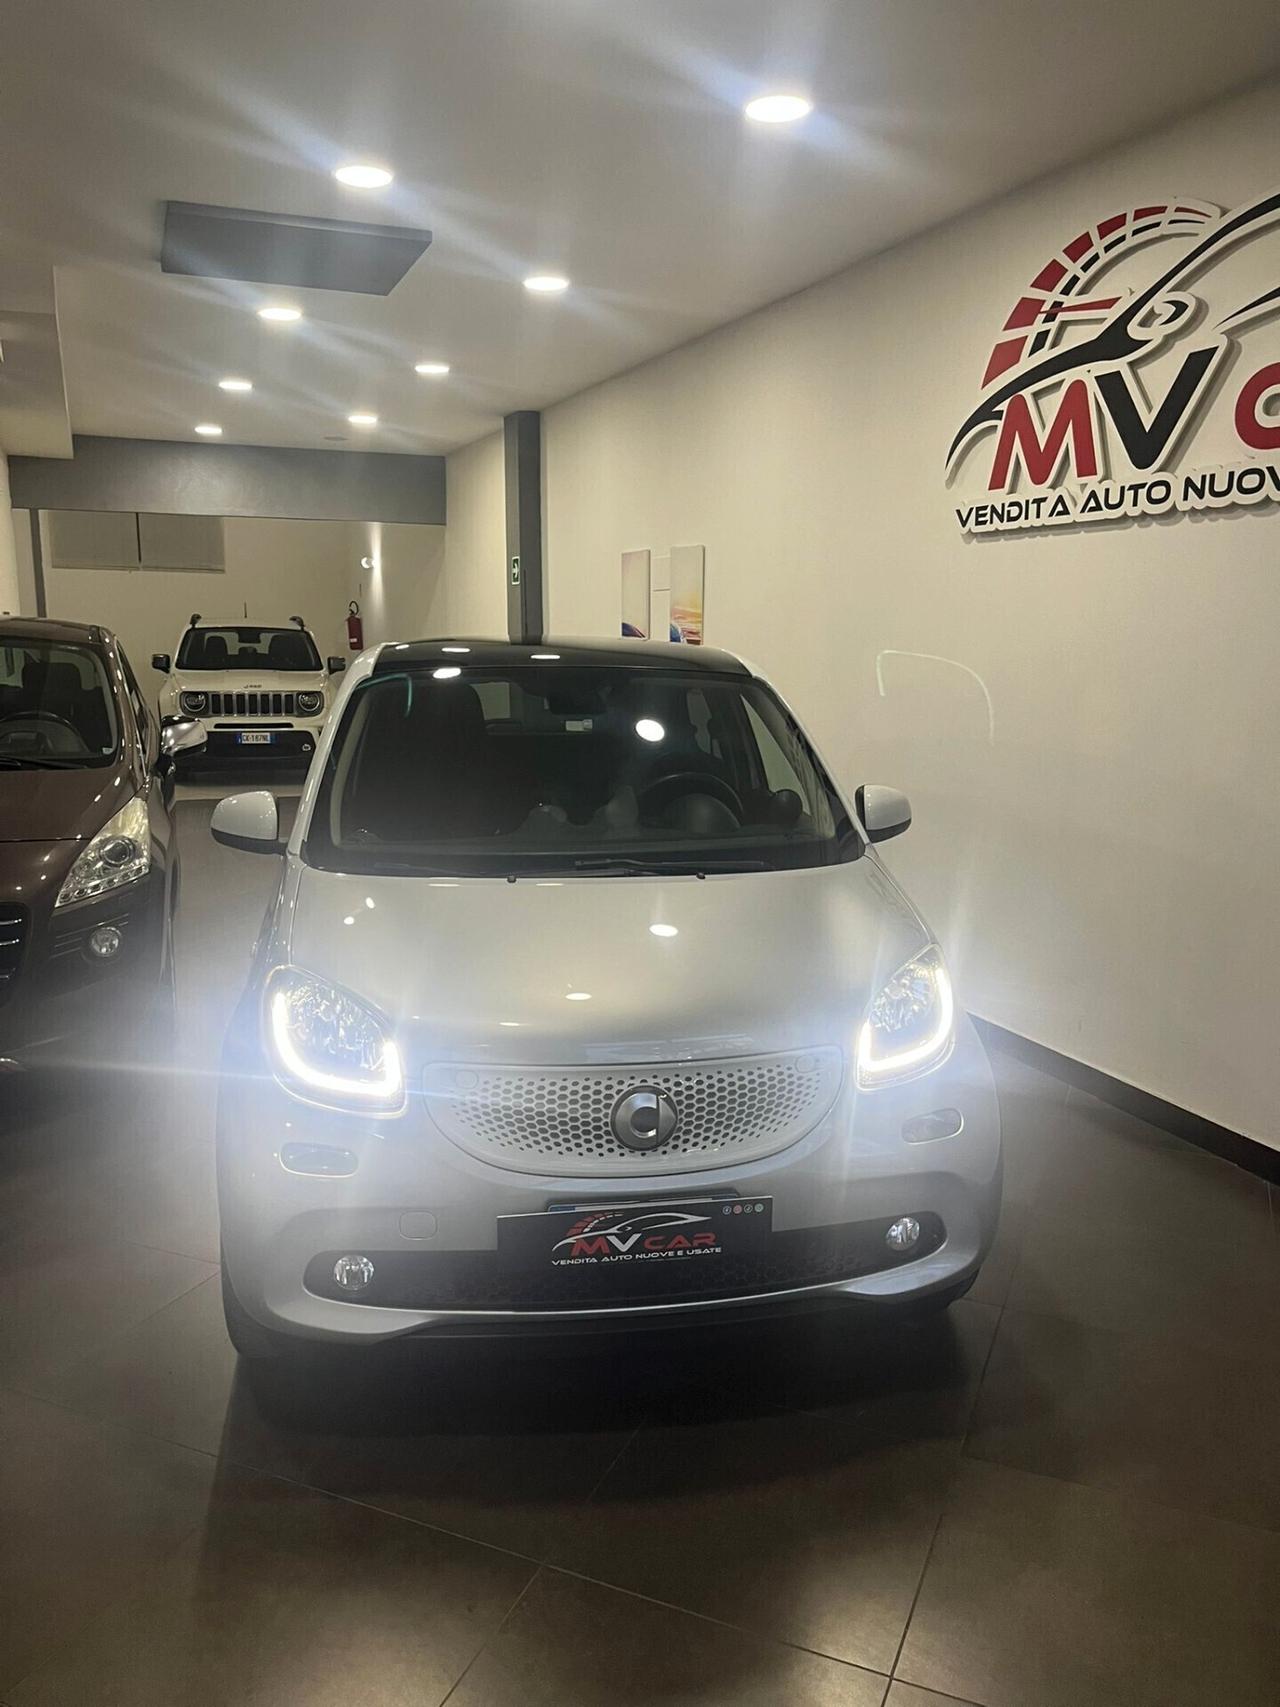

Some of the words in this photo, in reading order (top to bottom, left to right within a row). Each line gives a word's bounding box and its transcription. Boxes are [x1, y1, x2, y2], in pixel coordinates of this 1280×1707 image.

[955, 494, 1071, 528] VENDITA
[1079, 479, 1171, 514] AUTO
[644, 1232, 717, 1250] CAR
[551, 1257, 598, 1266] VENDITA
[601, 1254, 633, 1262] AUTO
[635, 1250, 675, 1259] NUOVE
[686, 1247, 722, 1255] USATE
